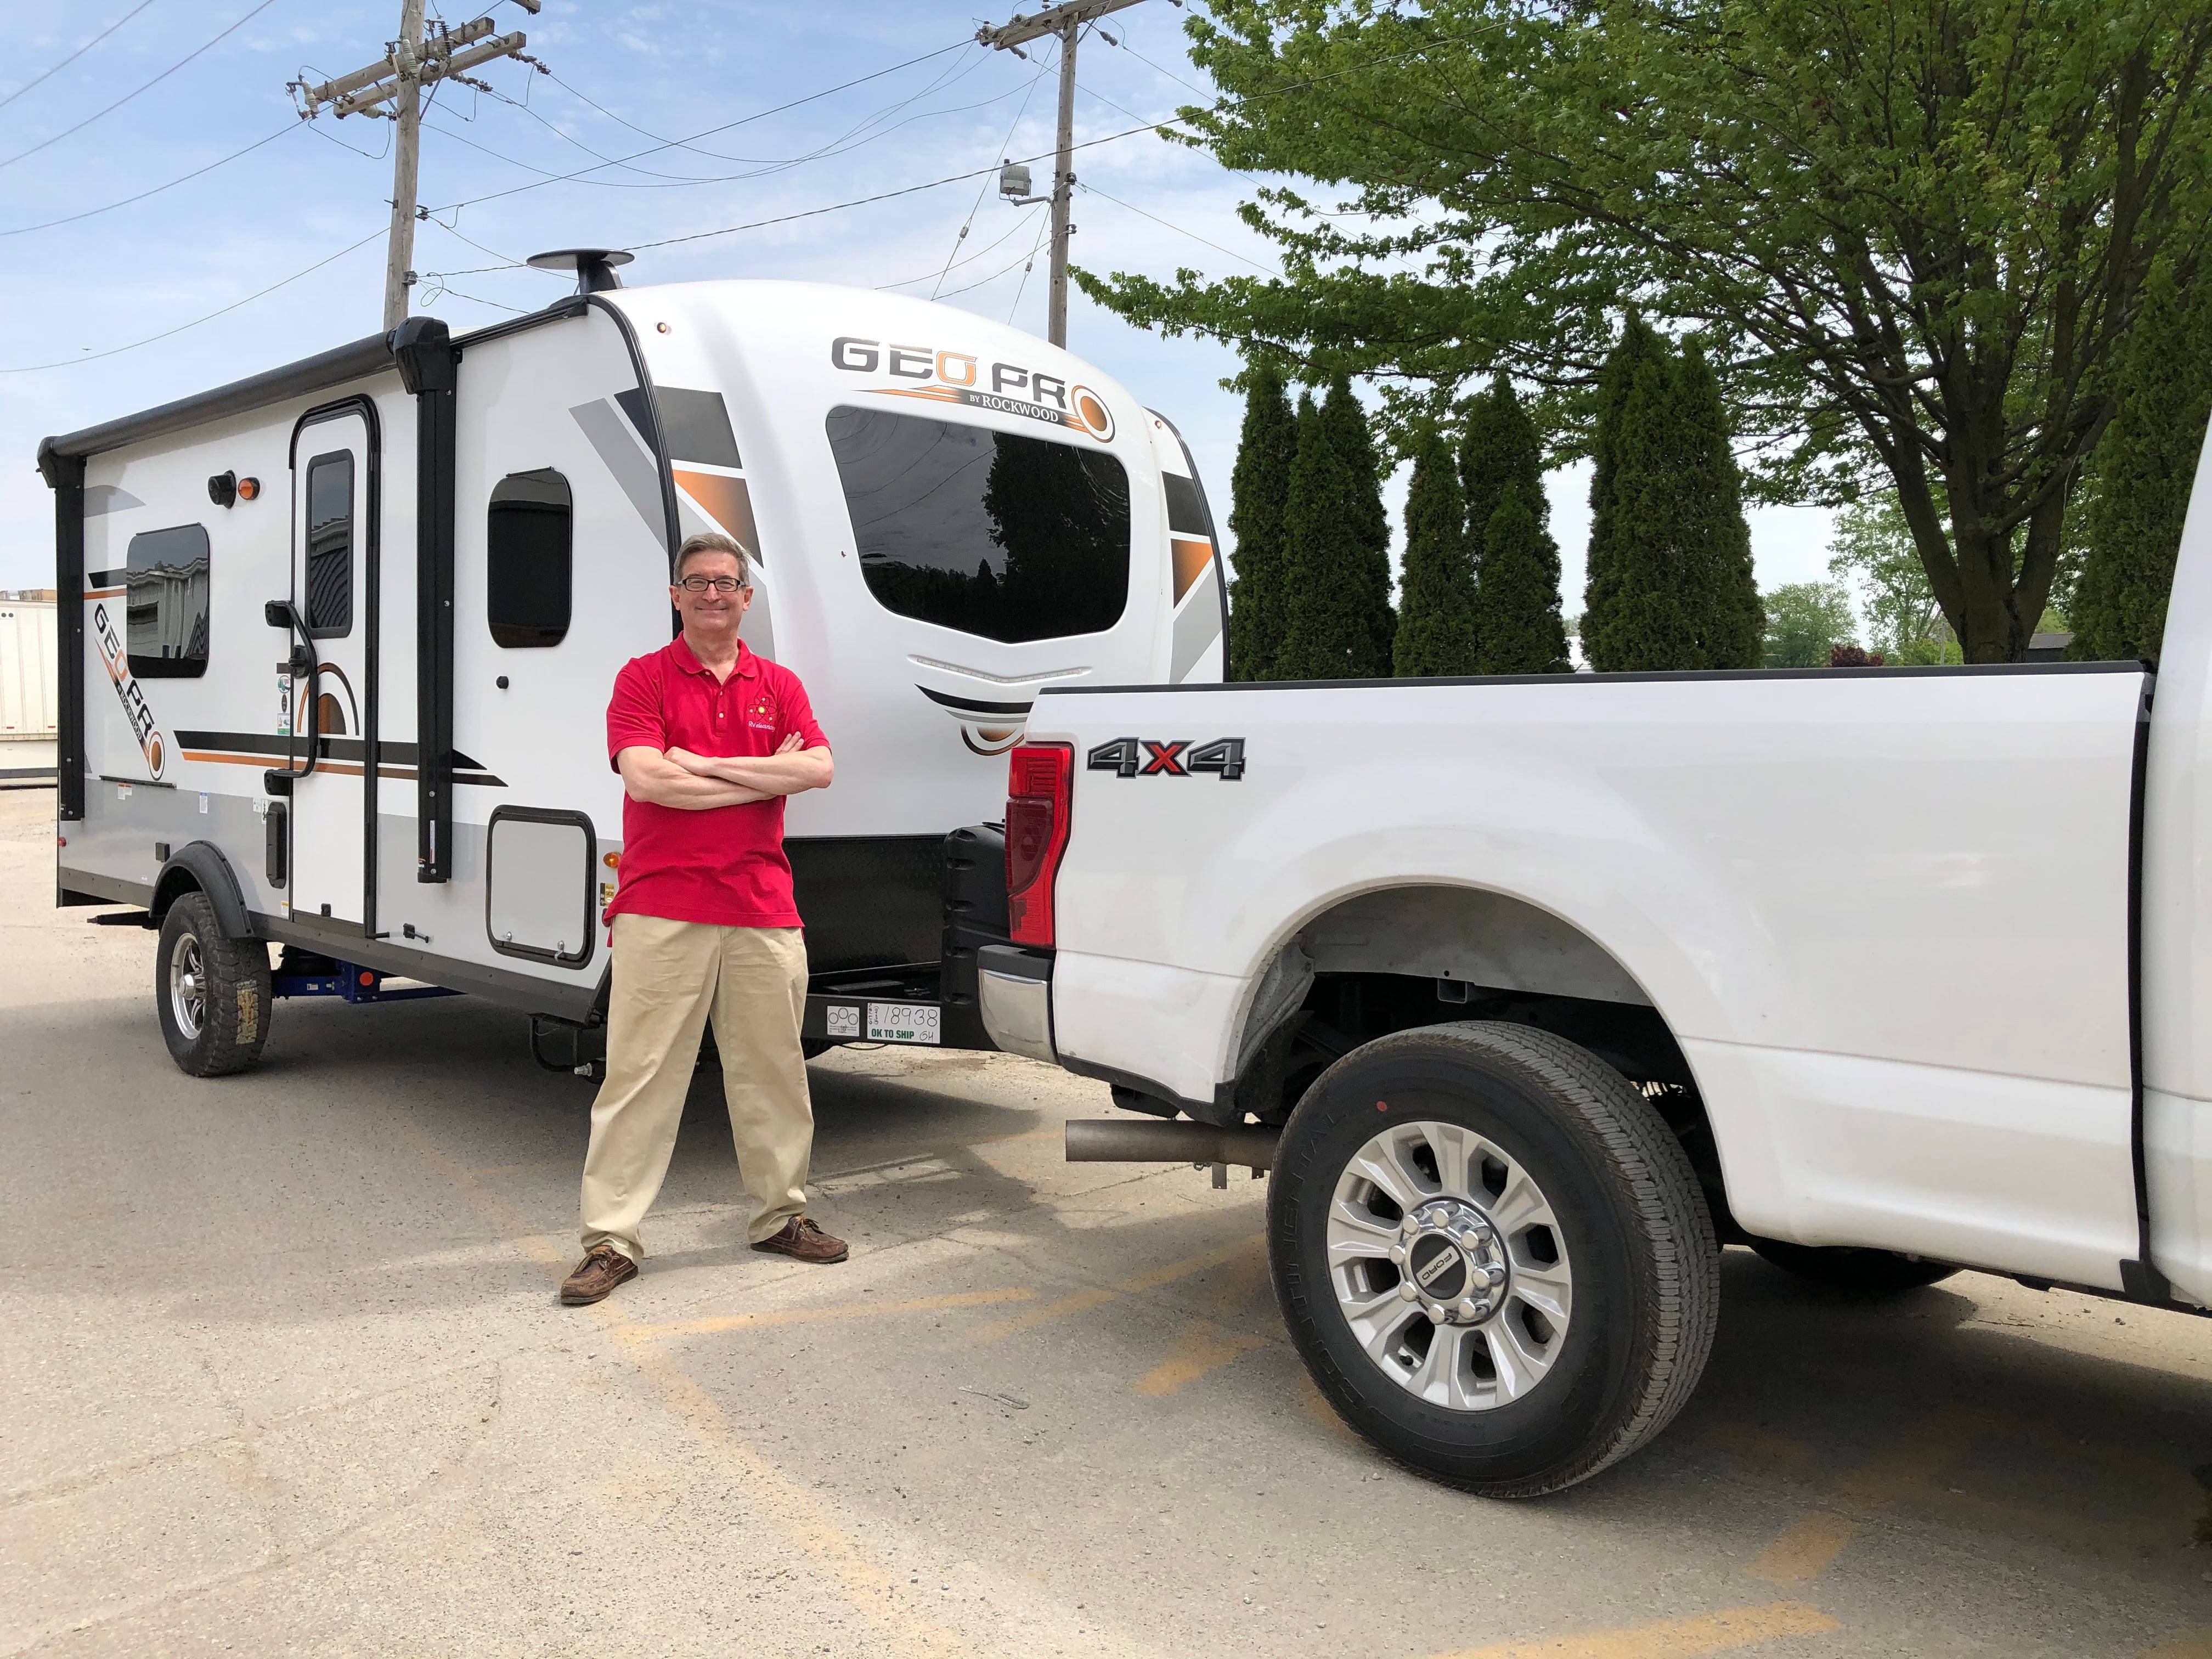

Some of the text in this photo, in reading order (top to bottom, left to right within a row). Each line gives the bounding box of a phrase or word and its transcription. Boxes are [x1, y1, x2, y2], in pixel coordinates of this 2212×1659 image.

[832, 336, 1115, 443] GEO PRO
[969, 394, 1059, 423] BY ROCKWOOD
[94, 603, 165, 781] GEO PRO
[120, 690, 143, 741] ROCKWOOD
[884, 1006, 938, 1027] 18938
[871, 1029, 915, 1039] OK TO SHIP
[1421, 1252, 1452, 1280] FORD
